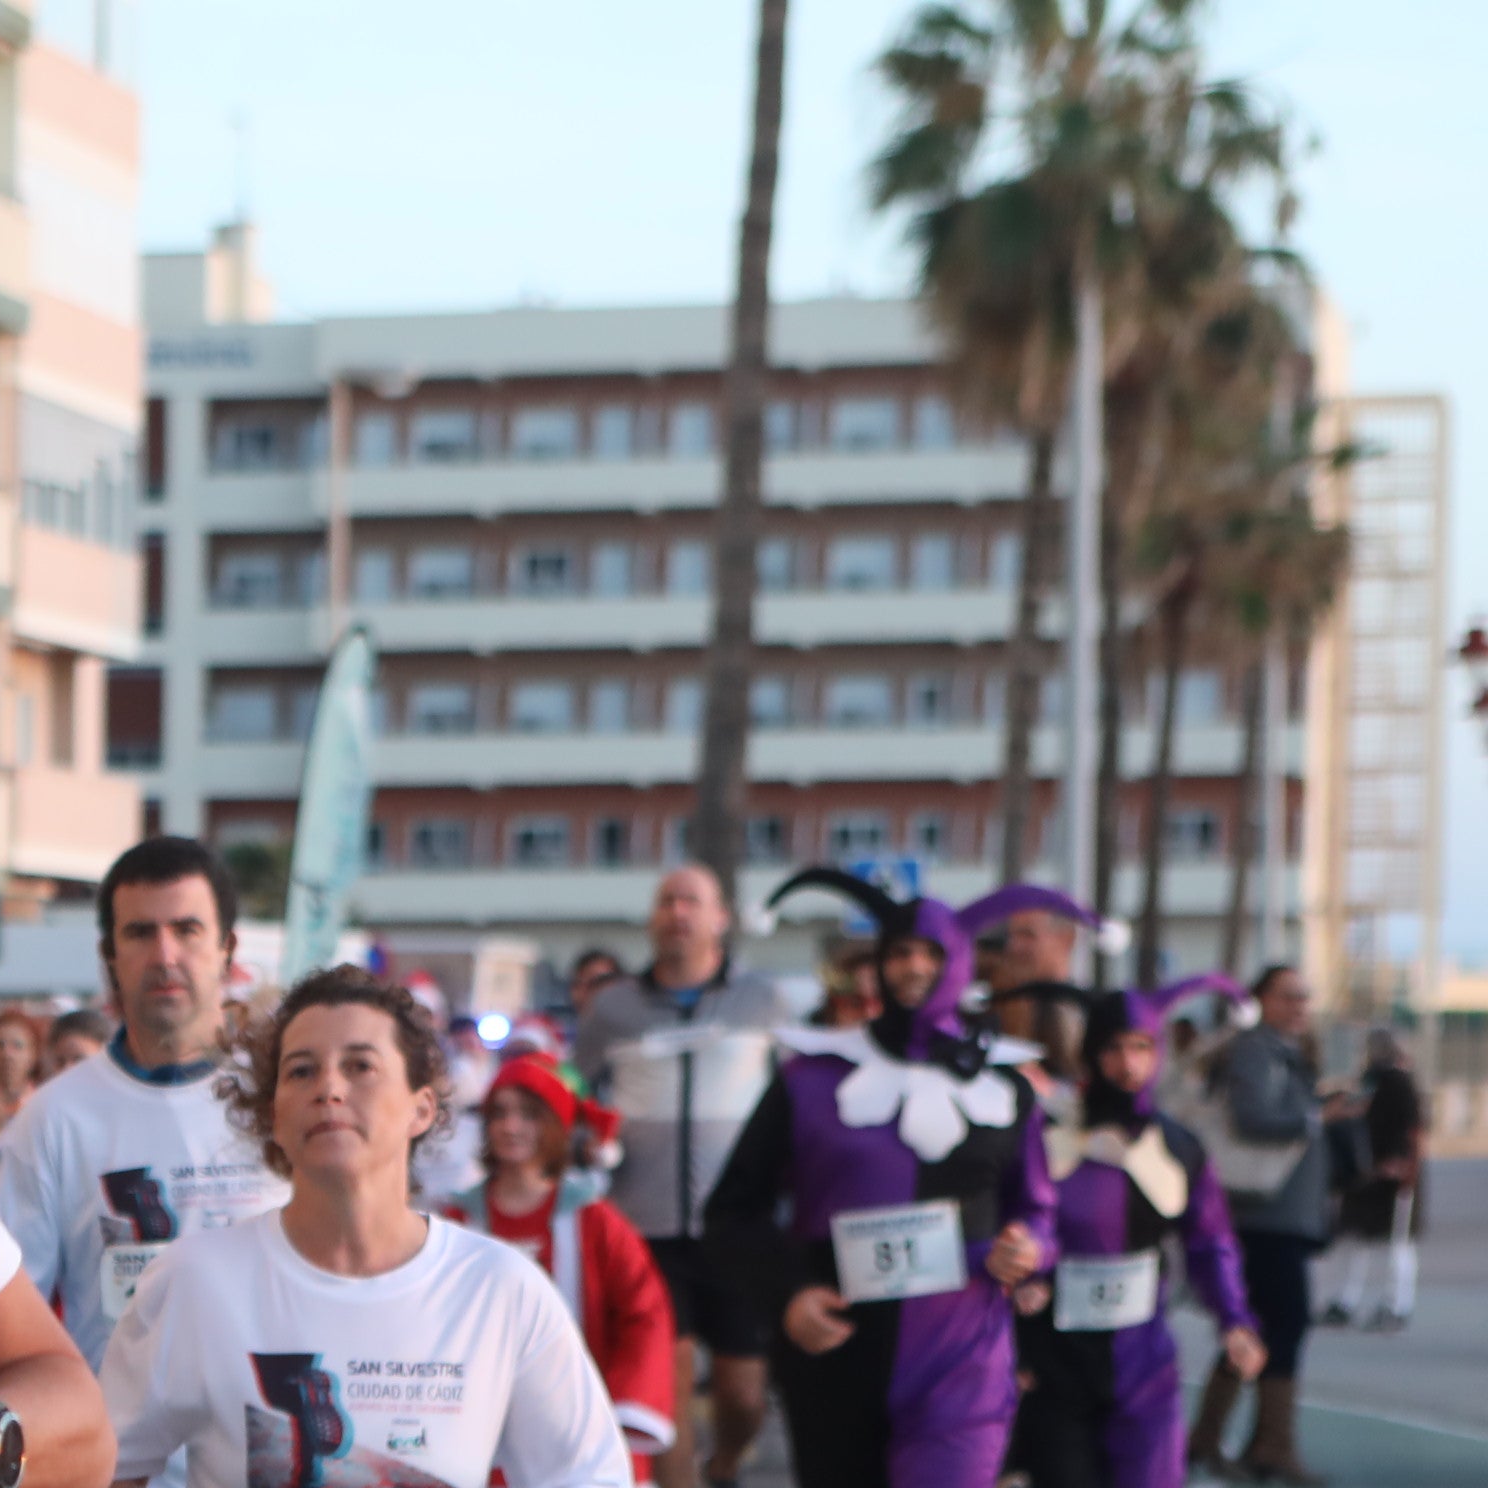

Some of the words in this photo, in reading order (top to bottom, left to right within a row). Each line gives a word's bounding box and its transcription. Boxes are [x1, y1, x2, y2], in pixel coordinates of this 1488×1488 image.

[347, 1360, 381, 1376] SAN
[385, 1361, 464, 1378] SILVESTRE
[347, 1383, 401, 1400] CIUDAD
[405, 1384, 423, 1400] DE
